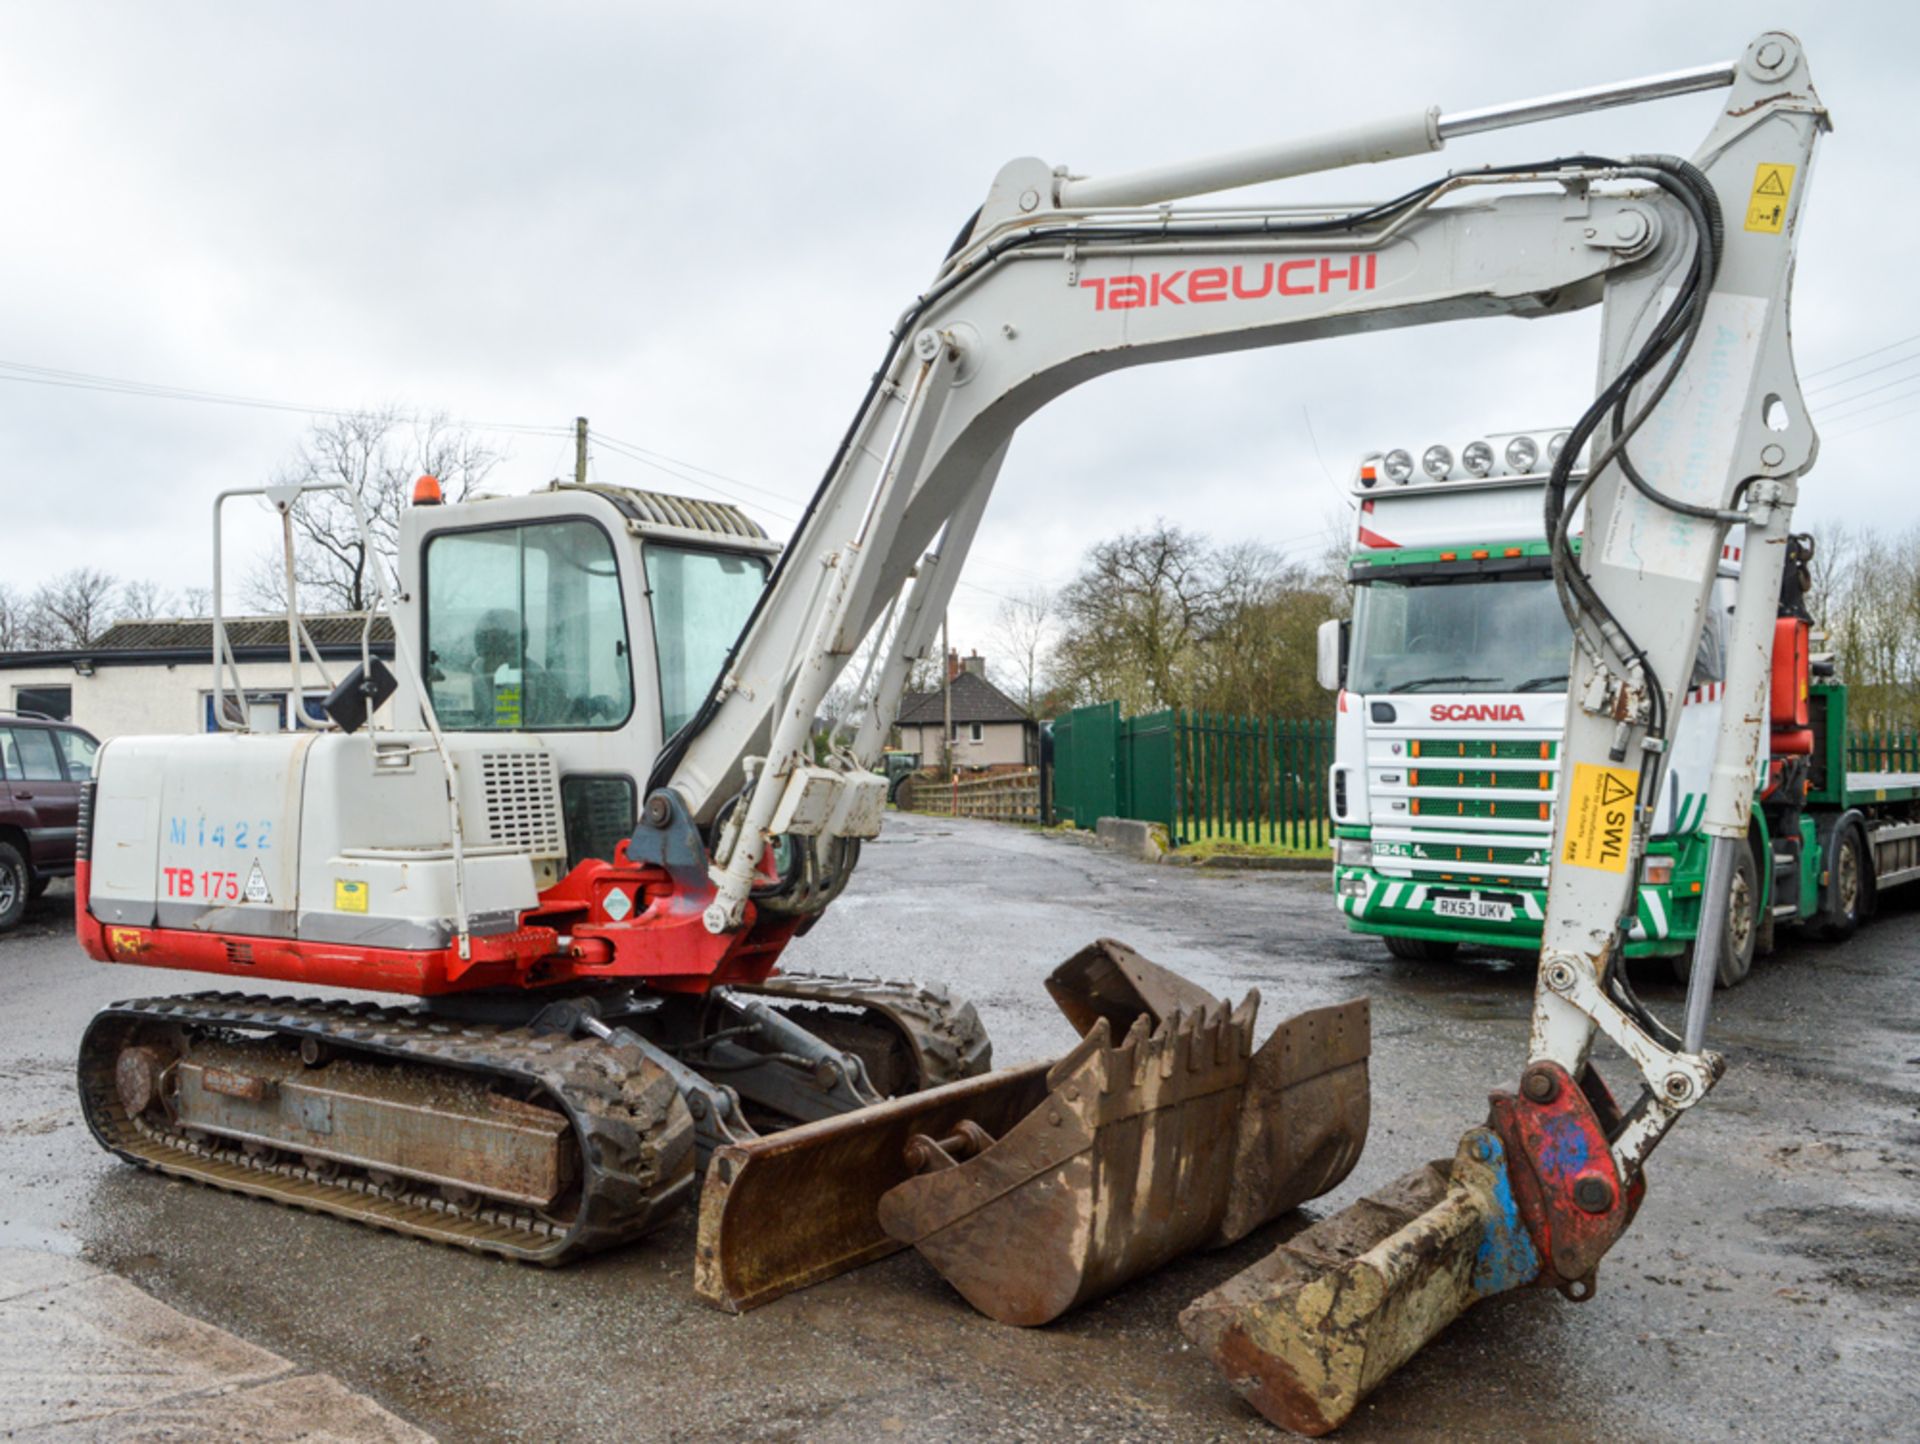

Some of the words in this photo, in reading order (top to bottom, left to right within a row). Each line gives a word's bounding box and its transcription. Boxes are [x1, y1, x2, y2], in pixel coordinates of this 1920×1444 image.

[1430, 704, 1525, 721] SCANIA
[1599, 810, 1626, 864] SWL
[1440, 899, 1476, 916] RX53
[1479, 903, 1507, 919] UKV
